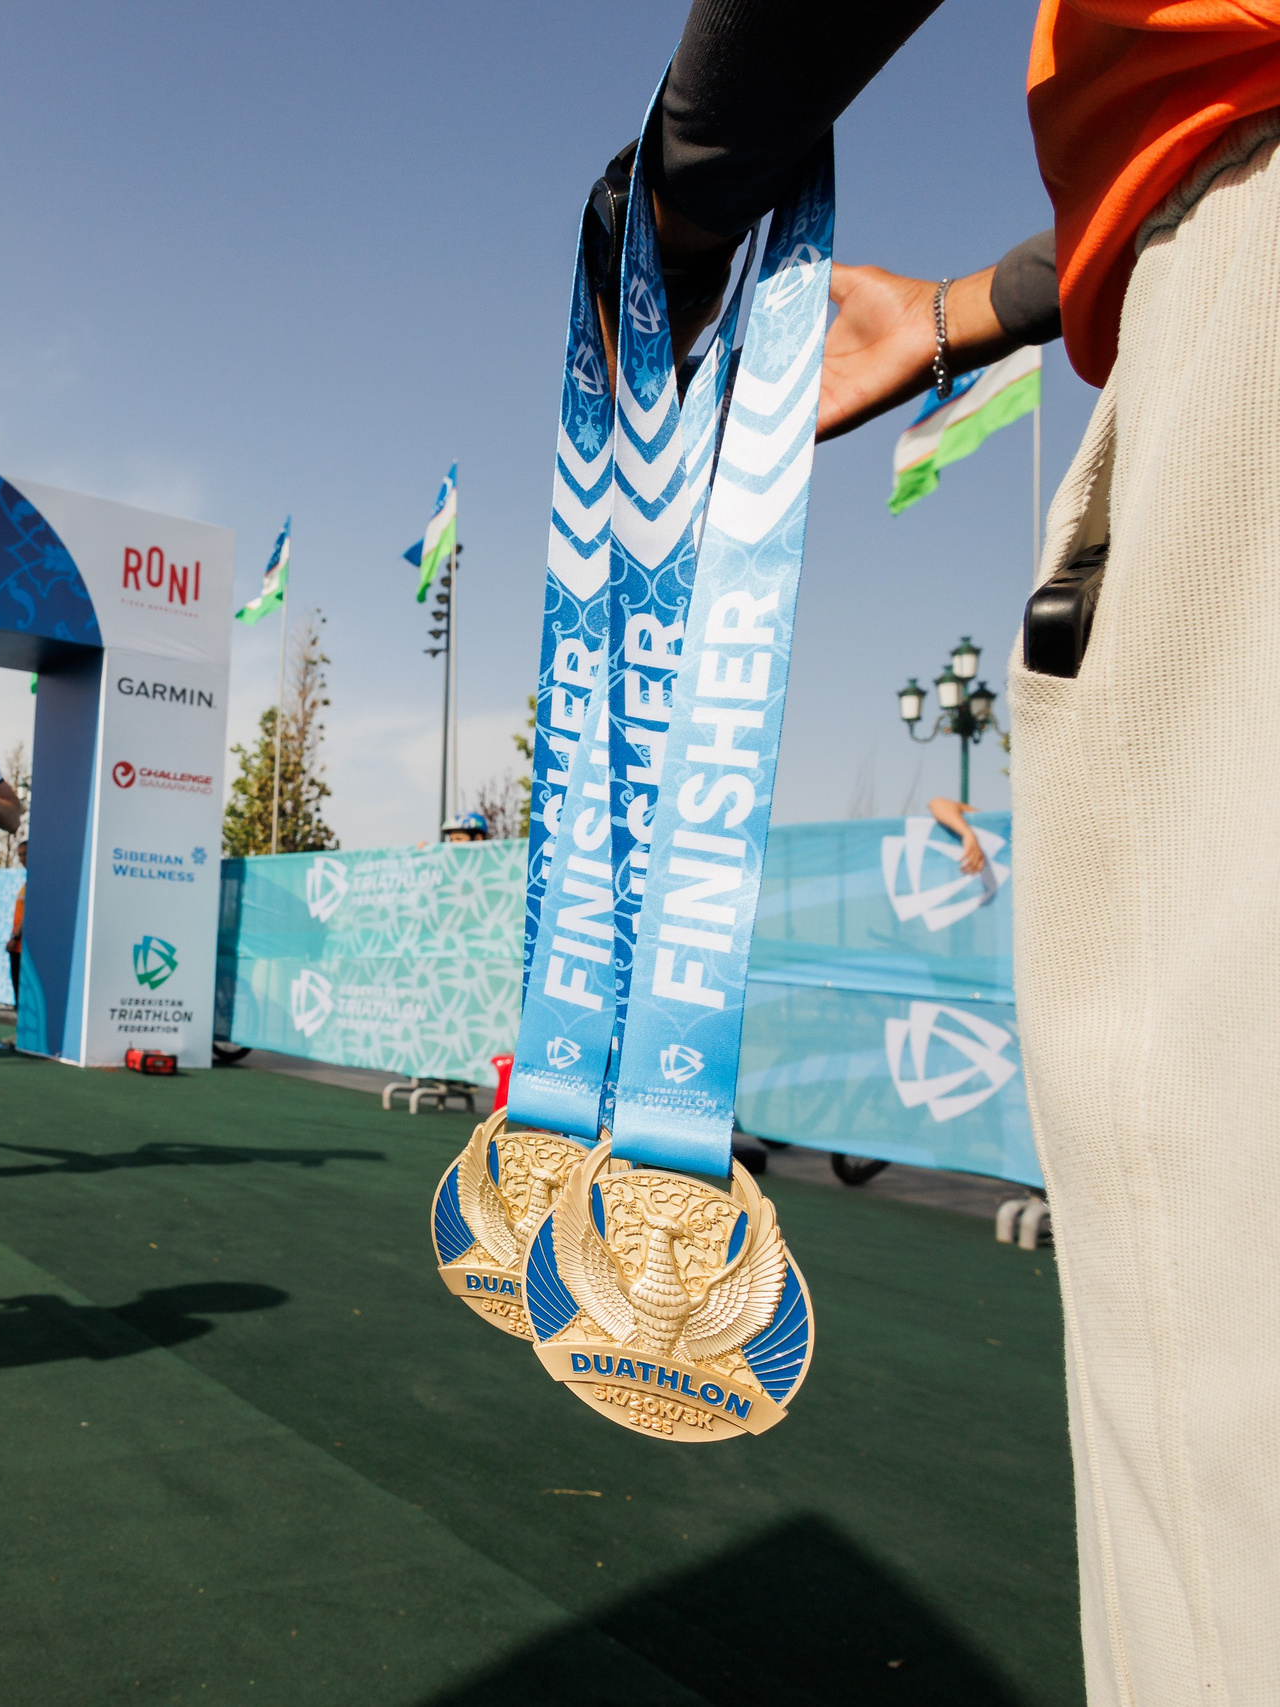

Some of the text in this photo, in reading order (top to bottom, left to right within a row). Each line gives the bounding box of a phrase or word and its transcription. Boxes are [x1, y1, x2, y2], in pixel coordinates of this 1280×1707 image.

[122, 546, 201, 606] RONI
[117, 677, 214, 709] GARMIN
[139, 767, 213, 785] CHALLENGE
[651, 590, 781, 1011] FINISHER
[112, 848, 184, 866] SIBERIAN
[543, 701, 615, 1012] FINIS
[112, 864, 195, 883] WELLNESS
[120, 997, 184, 1007] UZBEKISTAN
[109, 1007, 193, 1022] TRIATHLON
[118, 1024, 179, 1033] FEDERATION
[637, 1093, 718, 1109] TRIATHLON
[647, 1087, 709, 1098] UZBEKISTAN
[465, 1272, 522, 1298] DUAT
[481, 1298, 528, 1323] 5K/20
[508, 1319, 534, 1337] 202
[570, 1351, 753, 1421] DUATHLON
[592, 1384, 714, 1431] 5K/20K/3K
[628, 1410, 674, 1435] 2025
